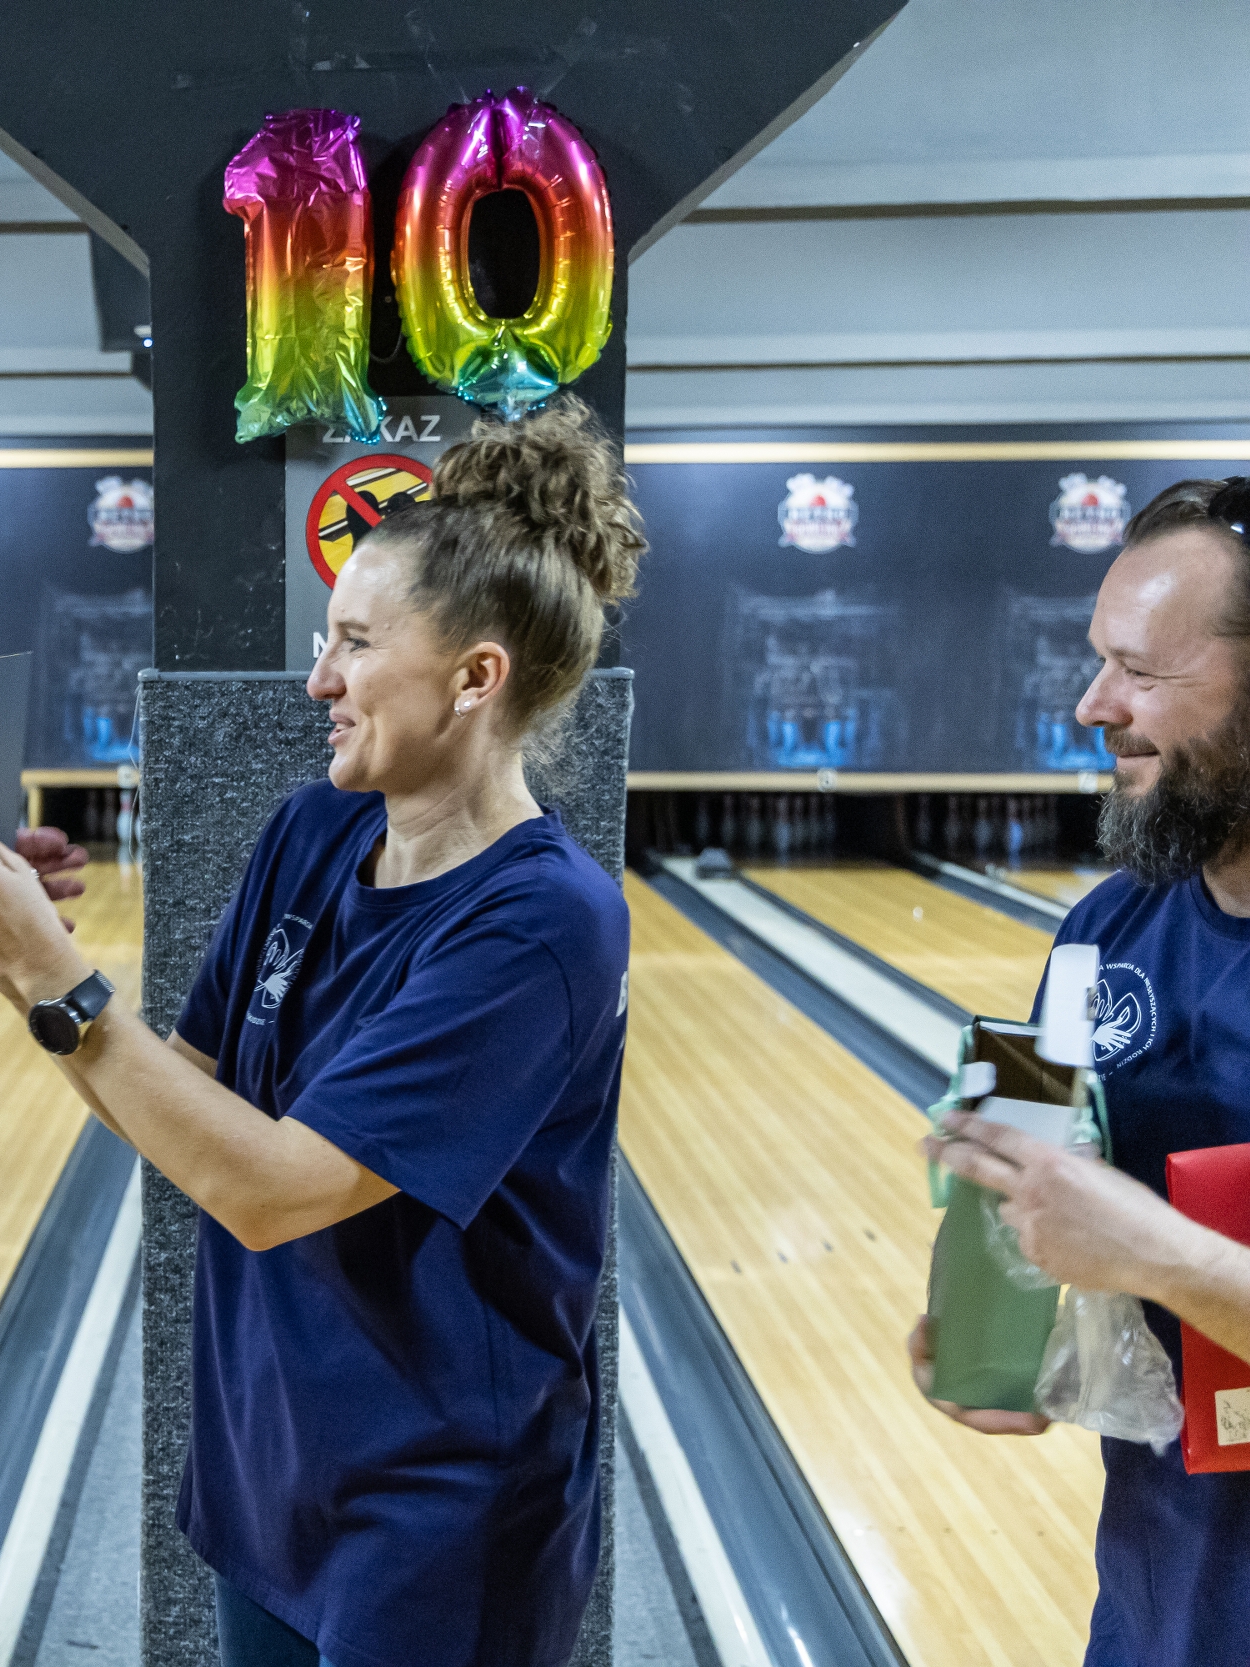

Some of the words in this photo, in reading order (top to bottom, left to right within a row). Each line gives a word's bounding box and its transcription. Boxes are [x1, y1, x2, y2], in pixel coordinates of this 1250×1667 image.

[322, 415, 441, 443] ZKAZ
[1133, 967, 1146, 979] DLA
[1142, 1038, 1154, 1051] ICH
[1116, 1048, 1143, 1069] RODZIN
